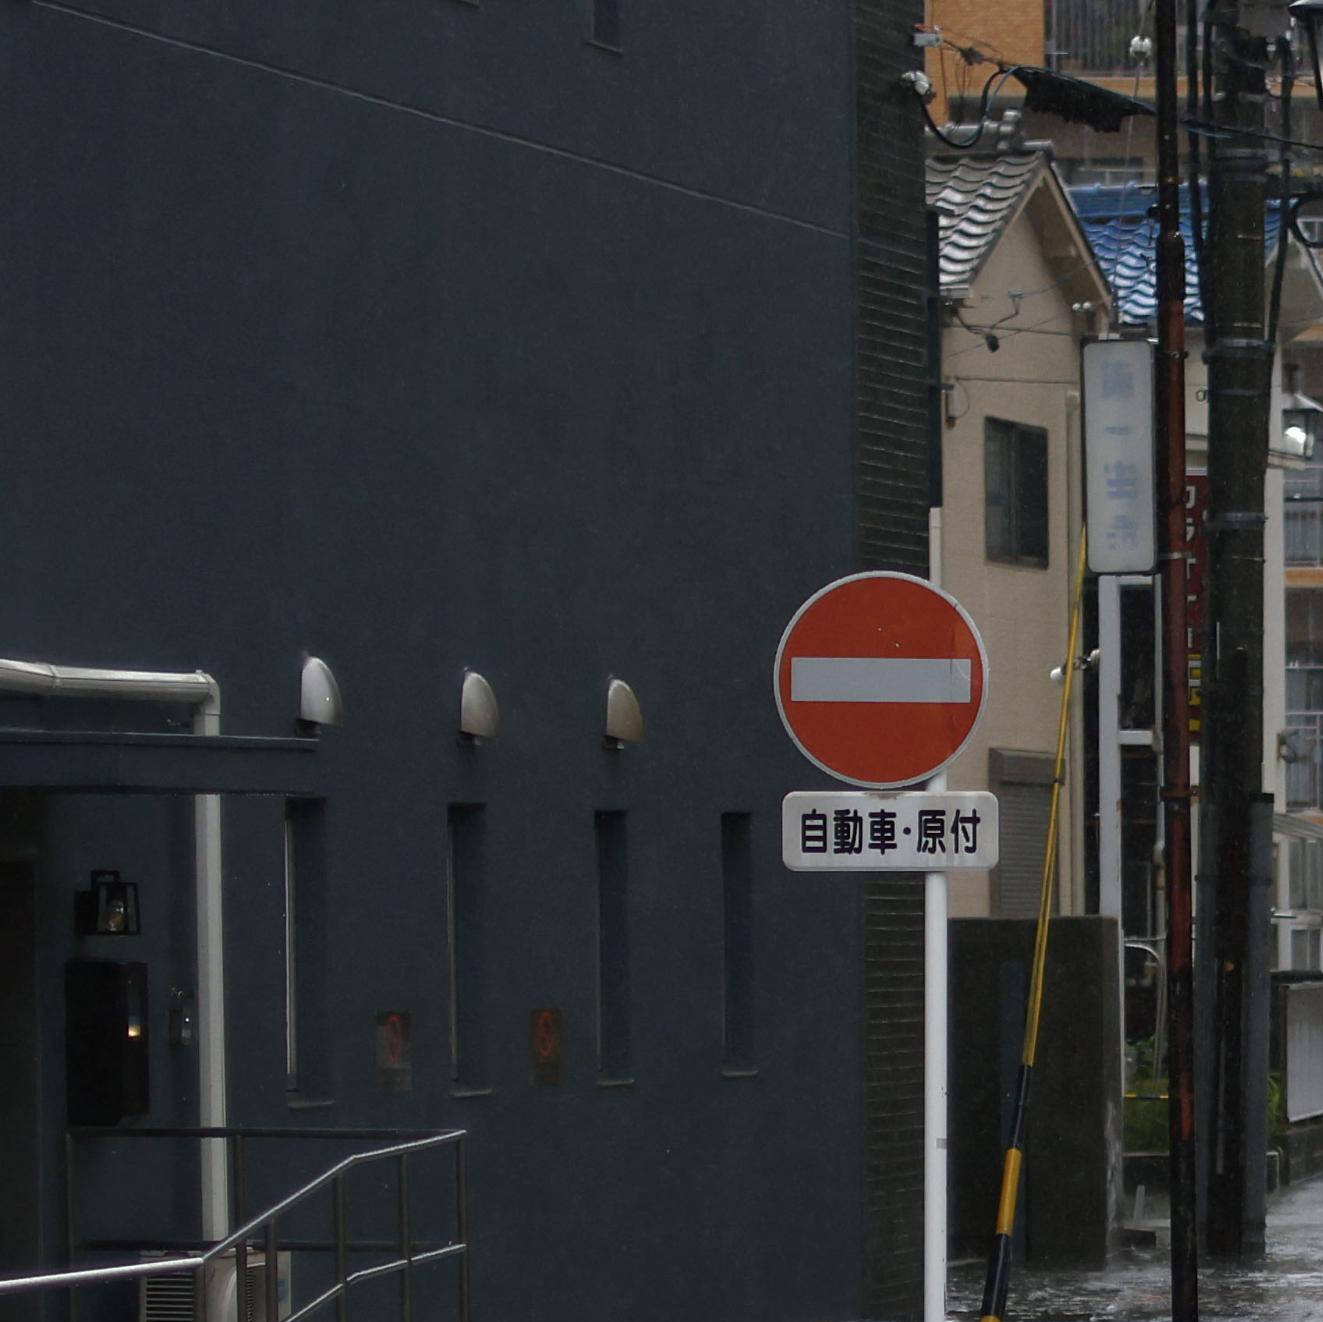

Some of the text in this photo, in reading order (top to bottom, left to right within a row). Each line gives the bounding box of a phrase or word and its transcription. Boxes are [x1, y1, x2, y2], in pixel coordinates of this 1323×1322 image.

[800, 808, 981, 855] 自動車・原付
